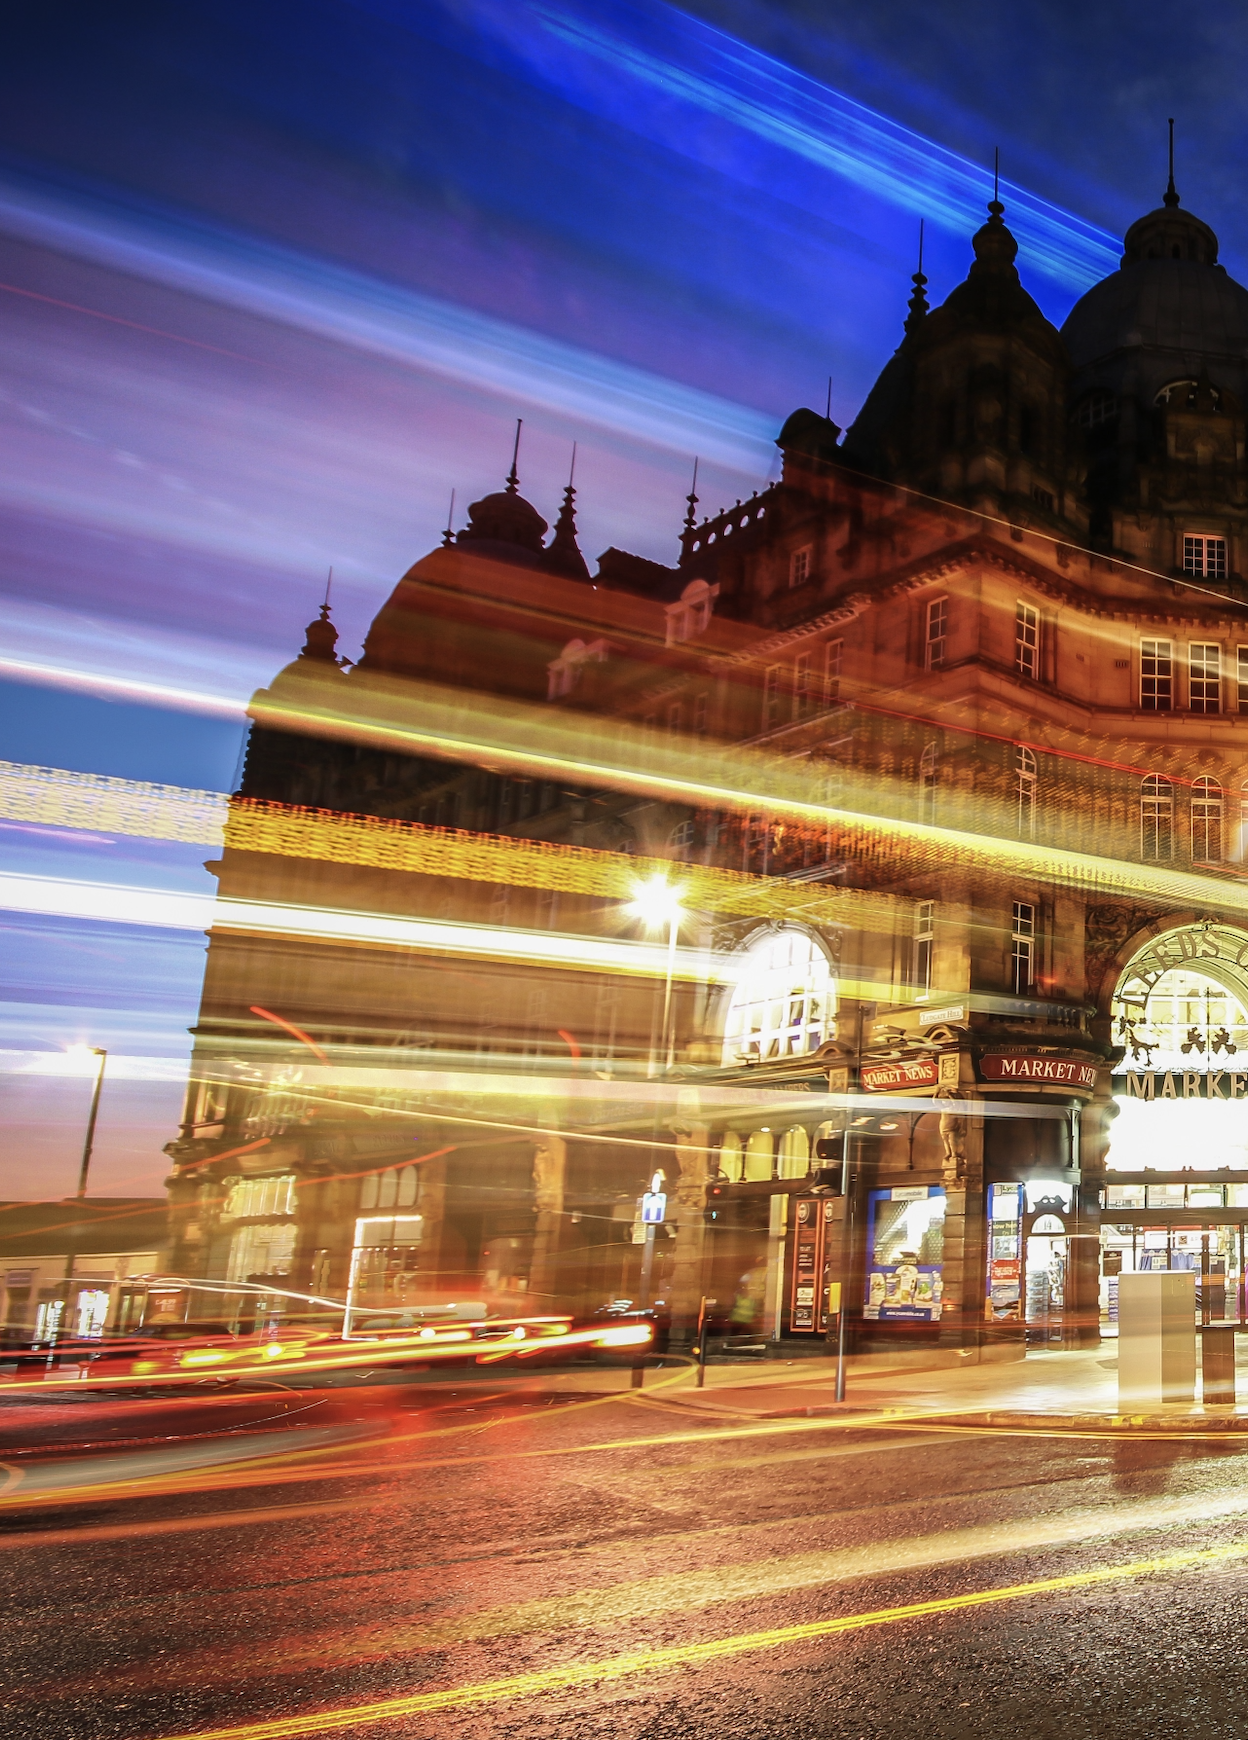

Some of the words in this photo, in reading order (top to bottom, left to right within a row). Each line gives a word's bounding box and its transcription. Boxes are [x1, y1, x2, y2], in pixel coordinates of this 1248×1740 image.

[1117, 931, 1220, 1010] LEEDS
[863, 1070, 901, 1086] MARKET
[904, 1066, 934, 1081] NEWS
[1000, 1059, 1076, 1080] MARKET
